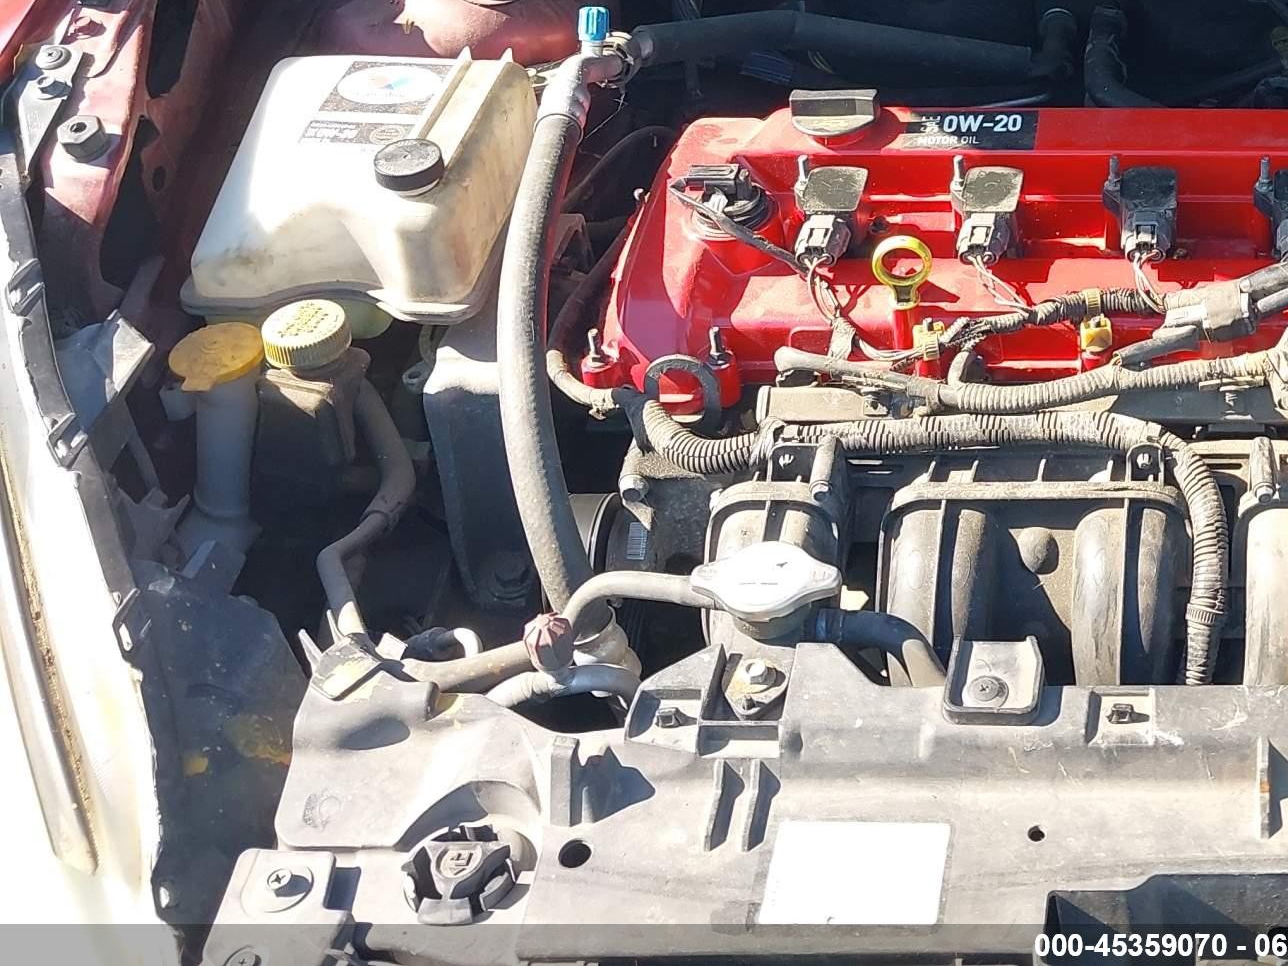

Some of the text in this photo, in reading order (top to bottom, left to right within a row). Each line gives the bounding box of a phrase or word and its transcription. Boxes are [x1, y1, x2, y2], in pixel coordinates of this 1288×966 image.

[943, 114, 1022, 133] 0W-20
[918, 135, 980, 146] MOTOR OIL
